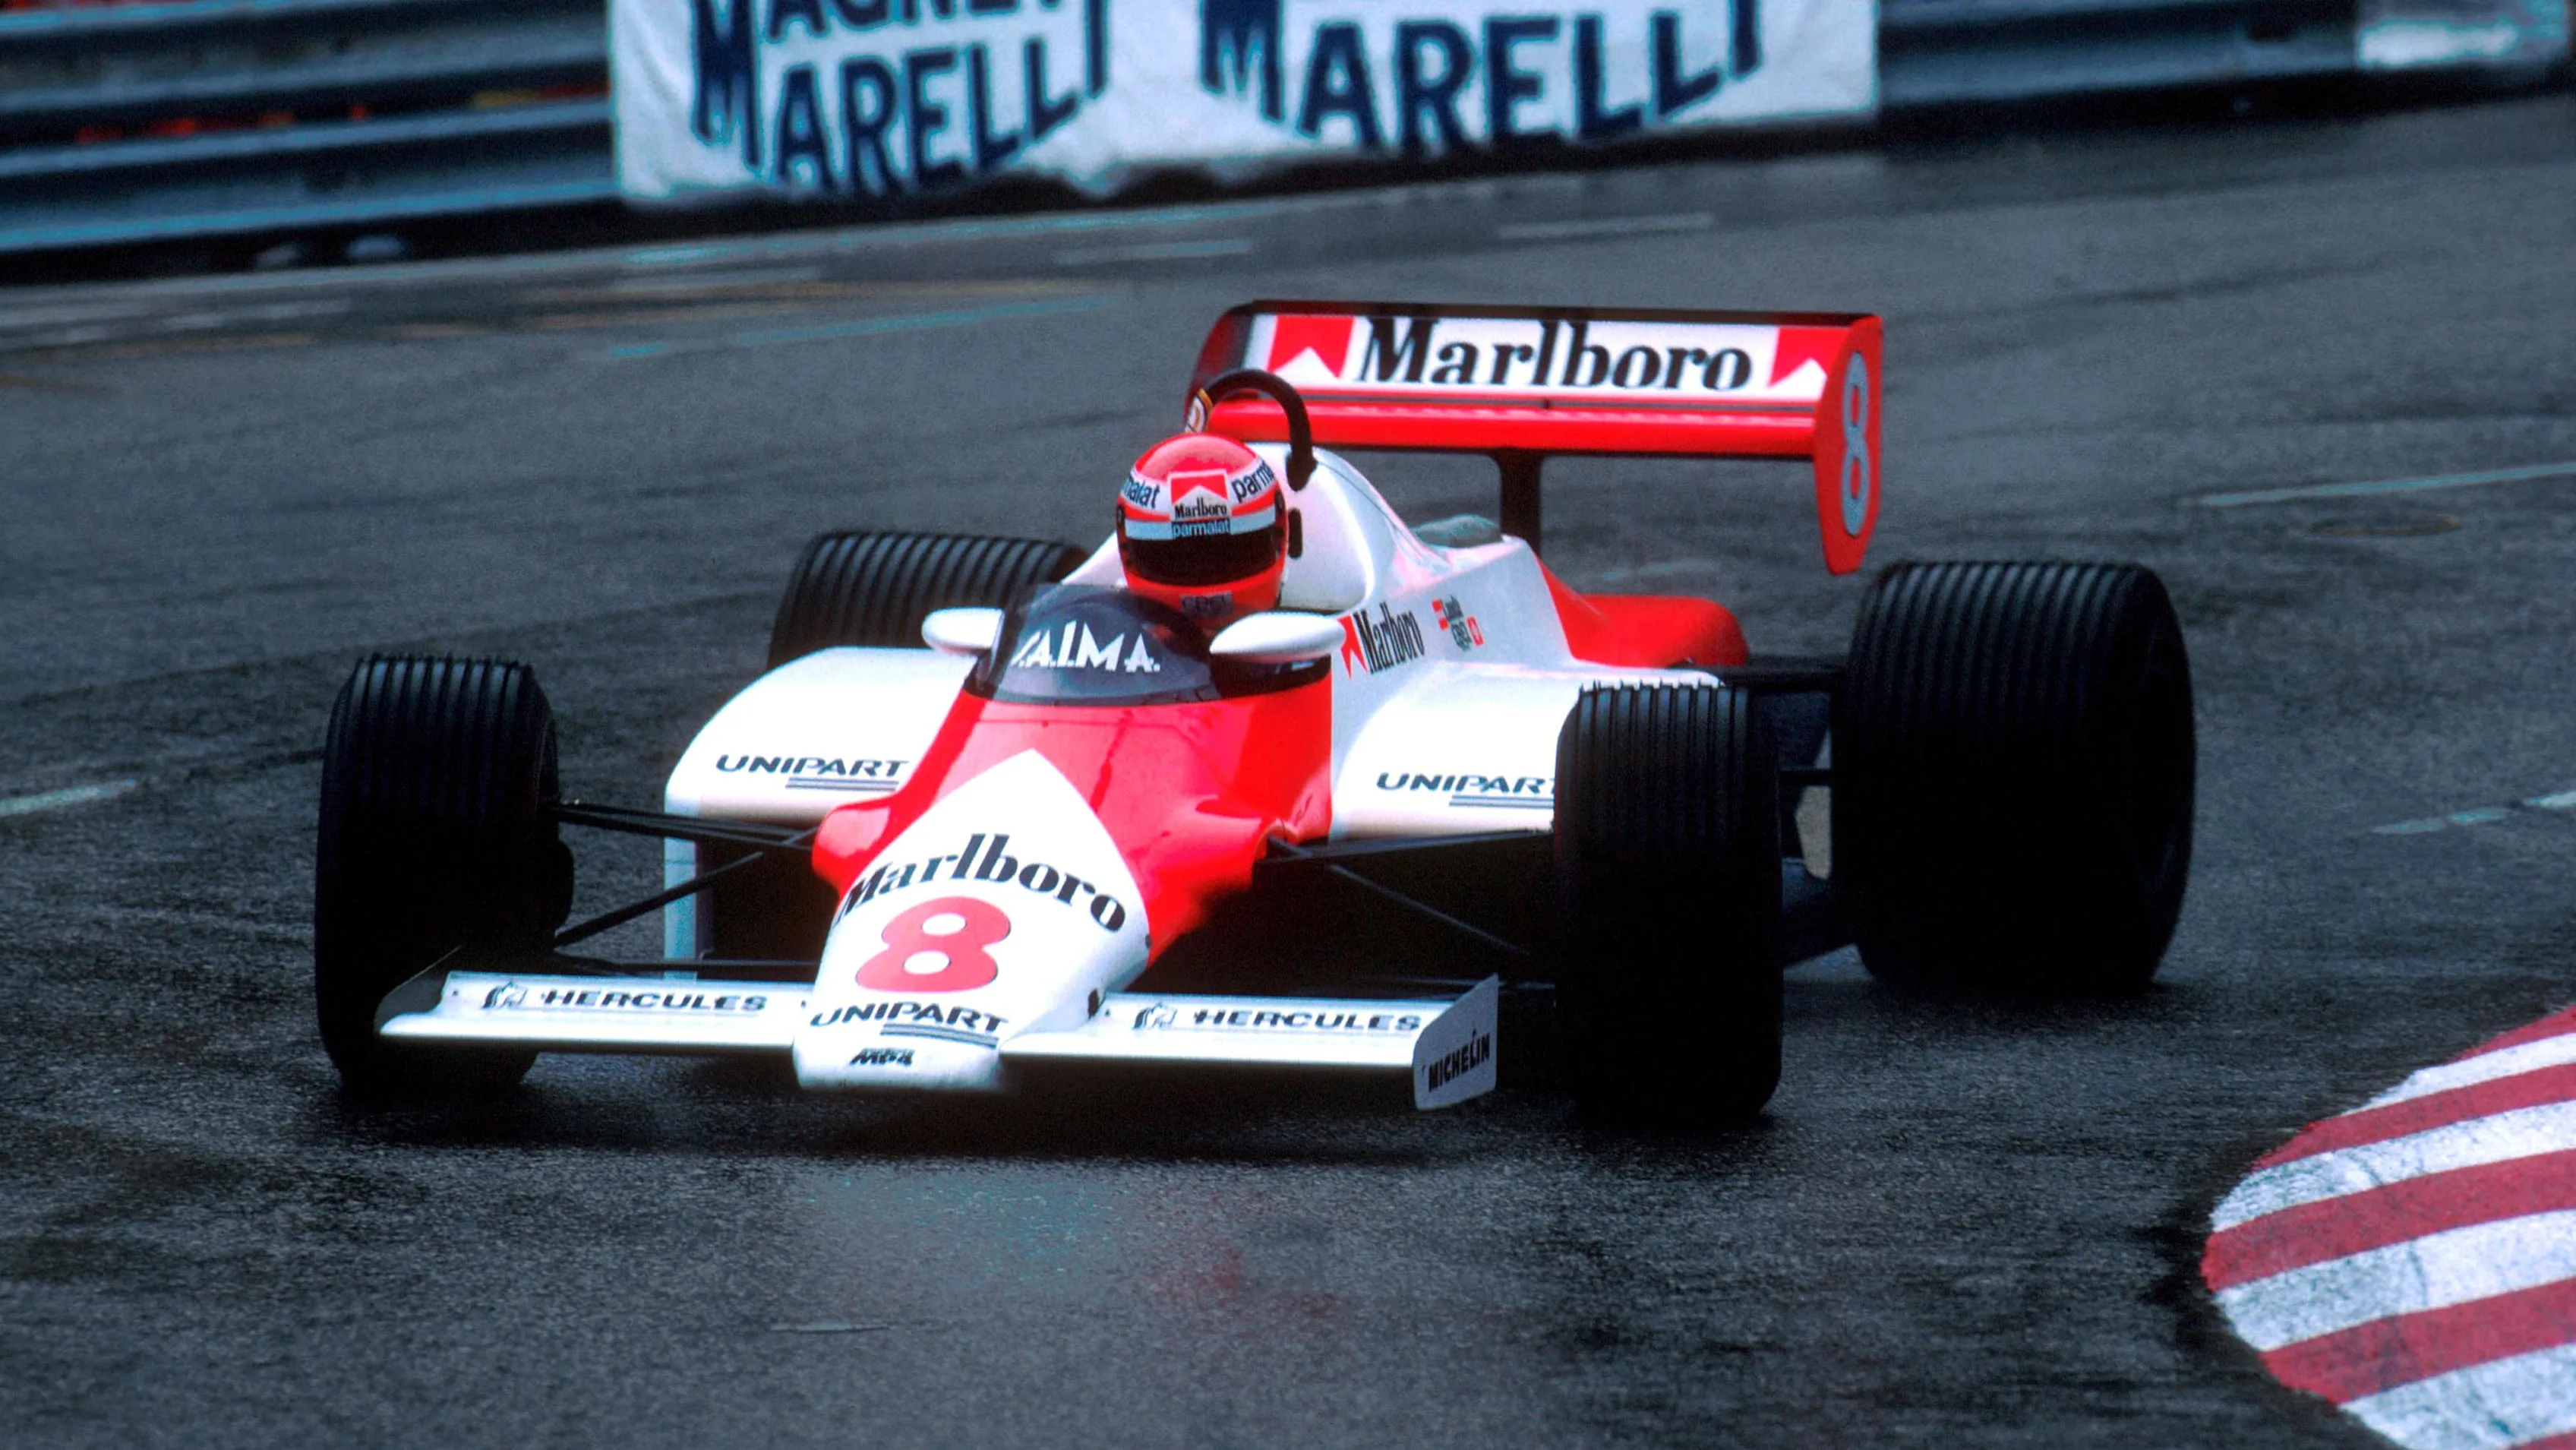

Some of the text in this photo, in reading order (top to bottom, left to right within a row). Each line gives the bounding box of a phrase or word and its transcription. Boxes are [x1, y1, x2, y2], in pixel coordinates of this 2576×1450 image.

[1359, 317, 1752, 390] Marlboro
[1840, 350, 1870, 537] 8
[1174, 497, 1227, 519] Marlboro
[1353, 601, 1425, 674] Marlboro
[715, 754, 909, 777] UNIPART
[1376, 772, 1555, 794] UNIPAR
[833, 833, 1125, 933] Marlboro
[855, 896, 1012, 994] 8
[541, 990, 766, 1012] HERCULES
[810, 1001, 1009, 1033] UNIPART
[1194, 1009, 1421, 1031] HERCULES
[1428, 1028, 1490, 1093] MICHELIN
